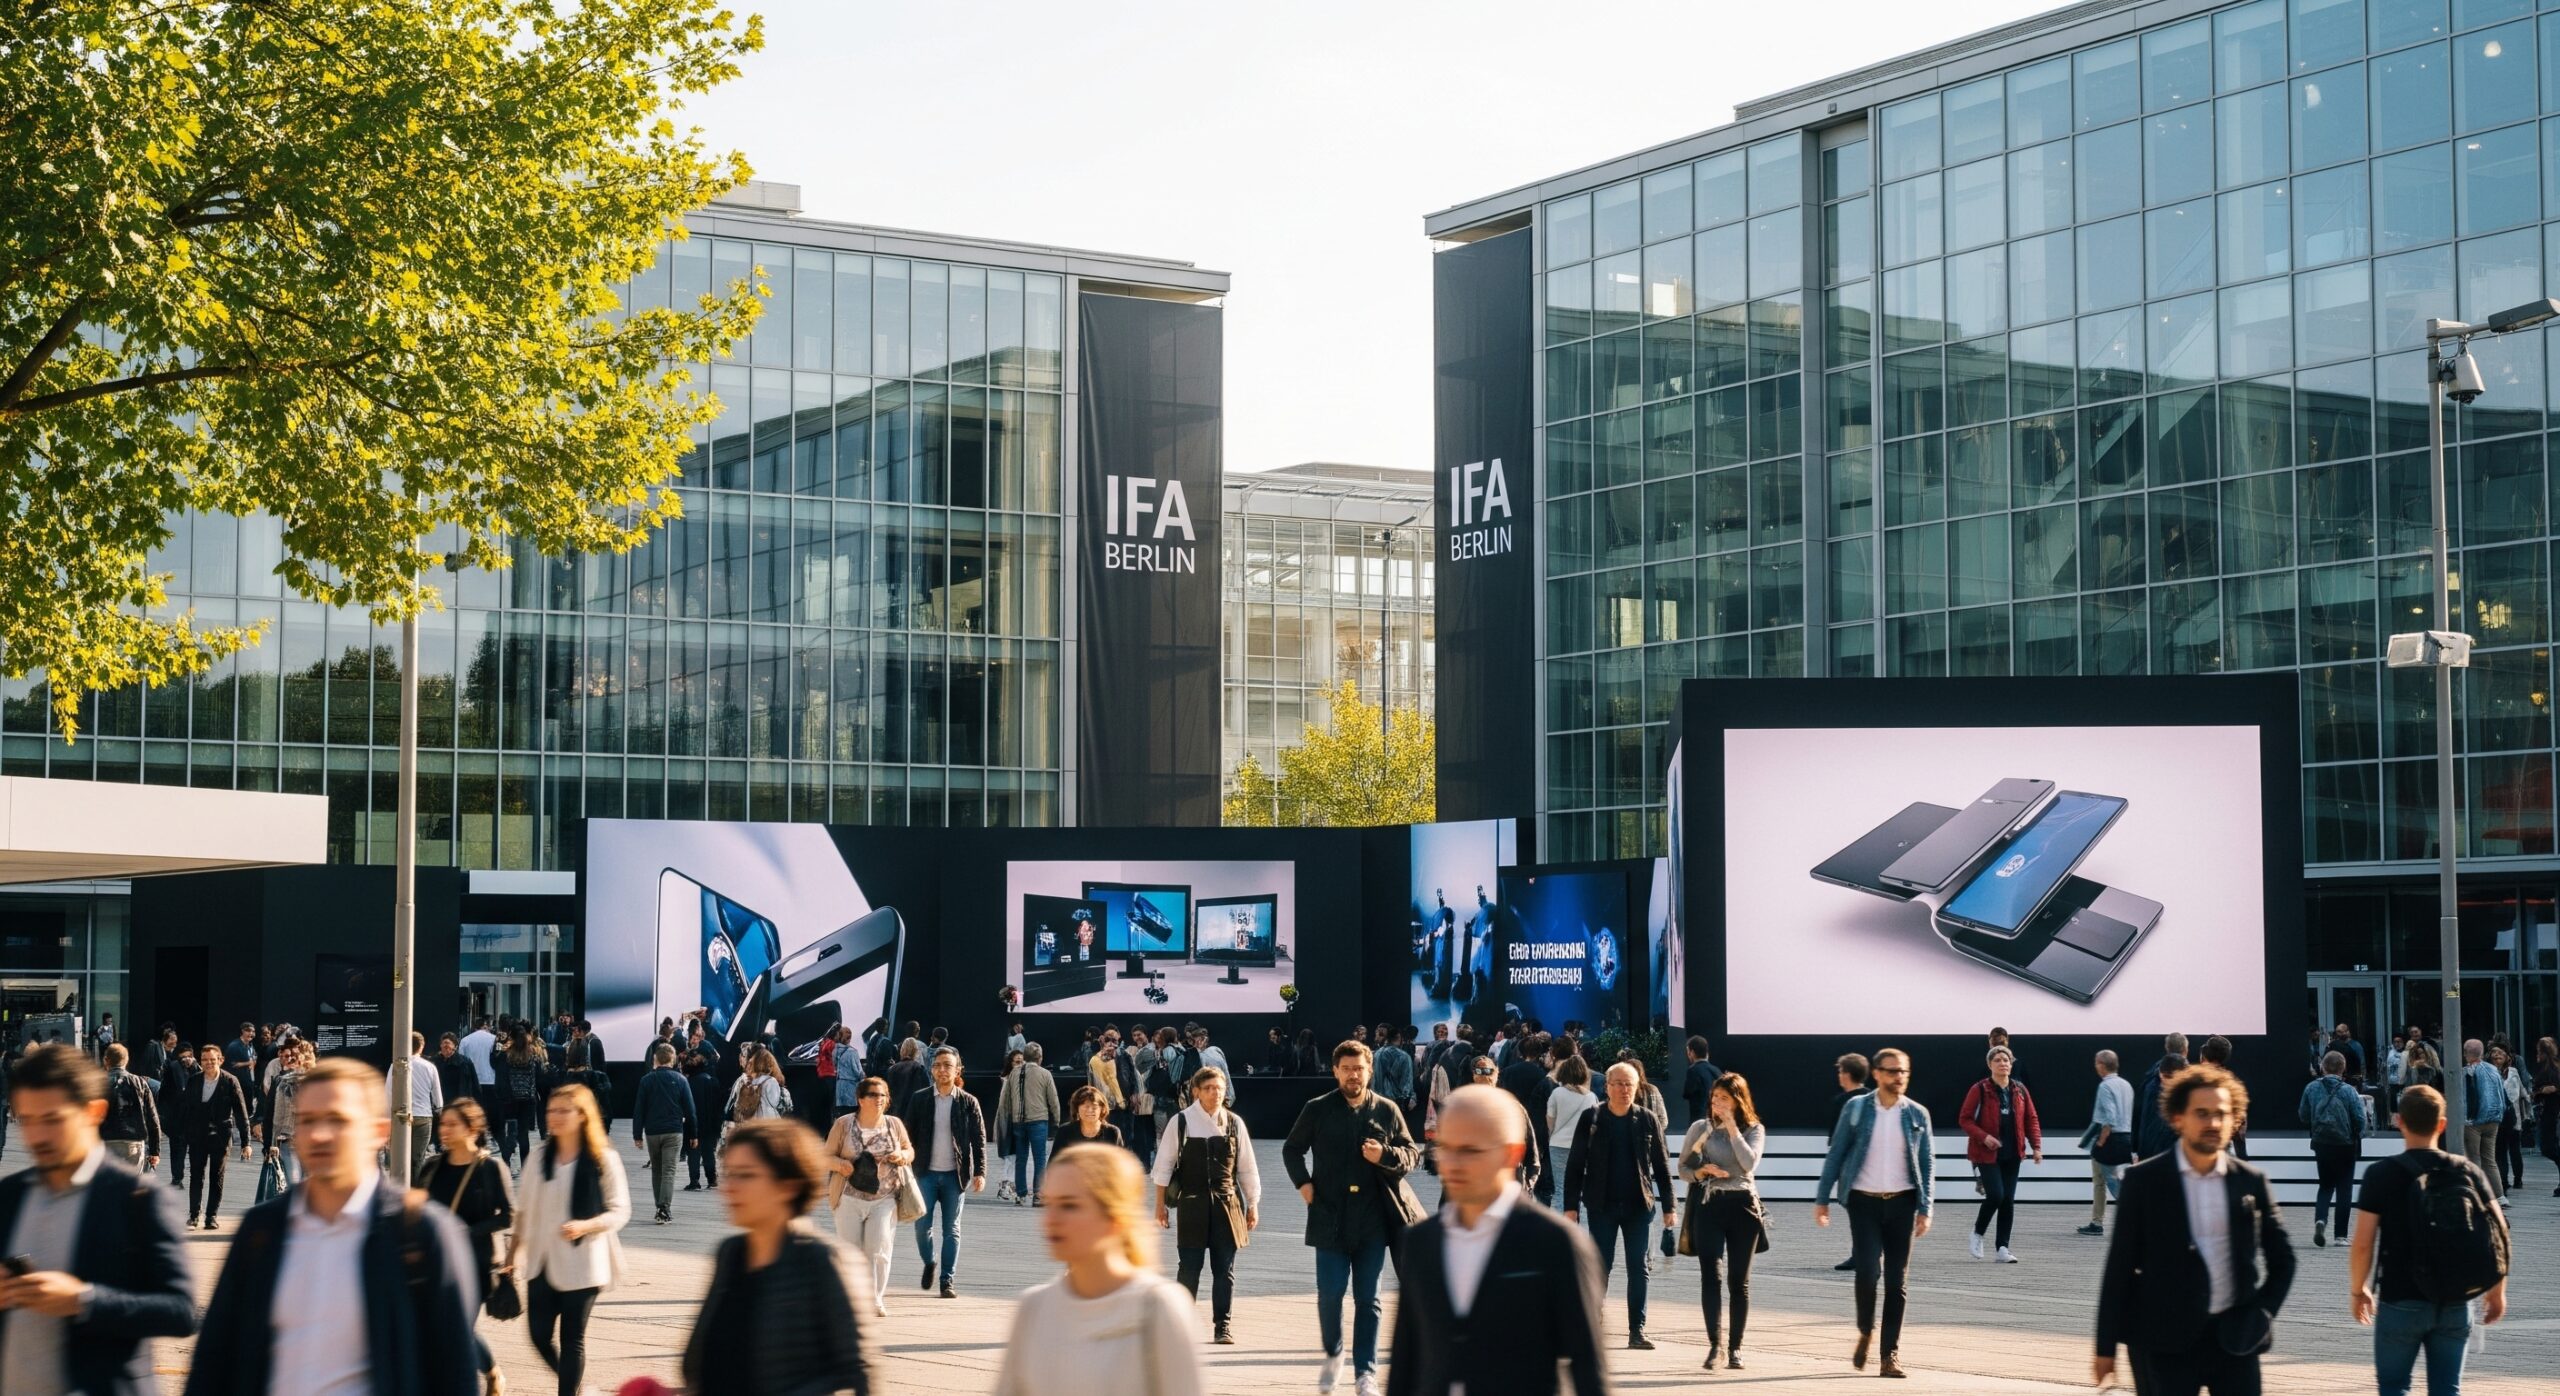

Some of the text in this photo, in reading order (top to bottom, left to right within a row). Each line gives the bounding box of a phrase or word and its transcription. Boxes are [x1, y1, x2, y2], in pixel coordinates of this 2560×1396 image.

[1107, 475, 1196, 541] IFA
[1451, 458, 1512, 527] IFA
[1105, 542, 1195, 574] BERLIN
[1451, 524, 1512, 561] BERLIN
